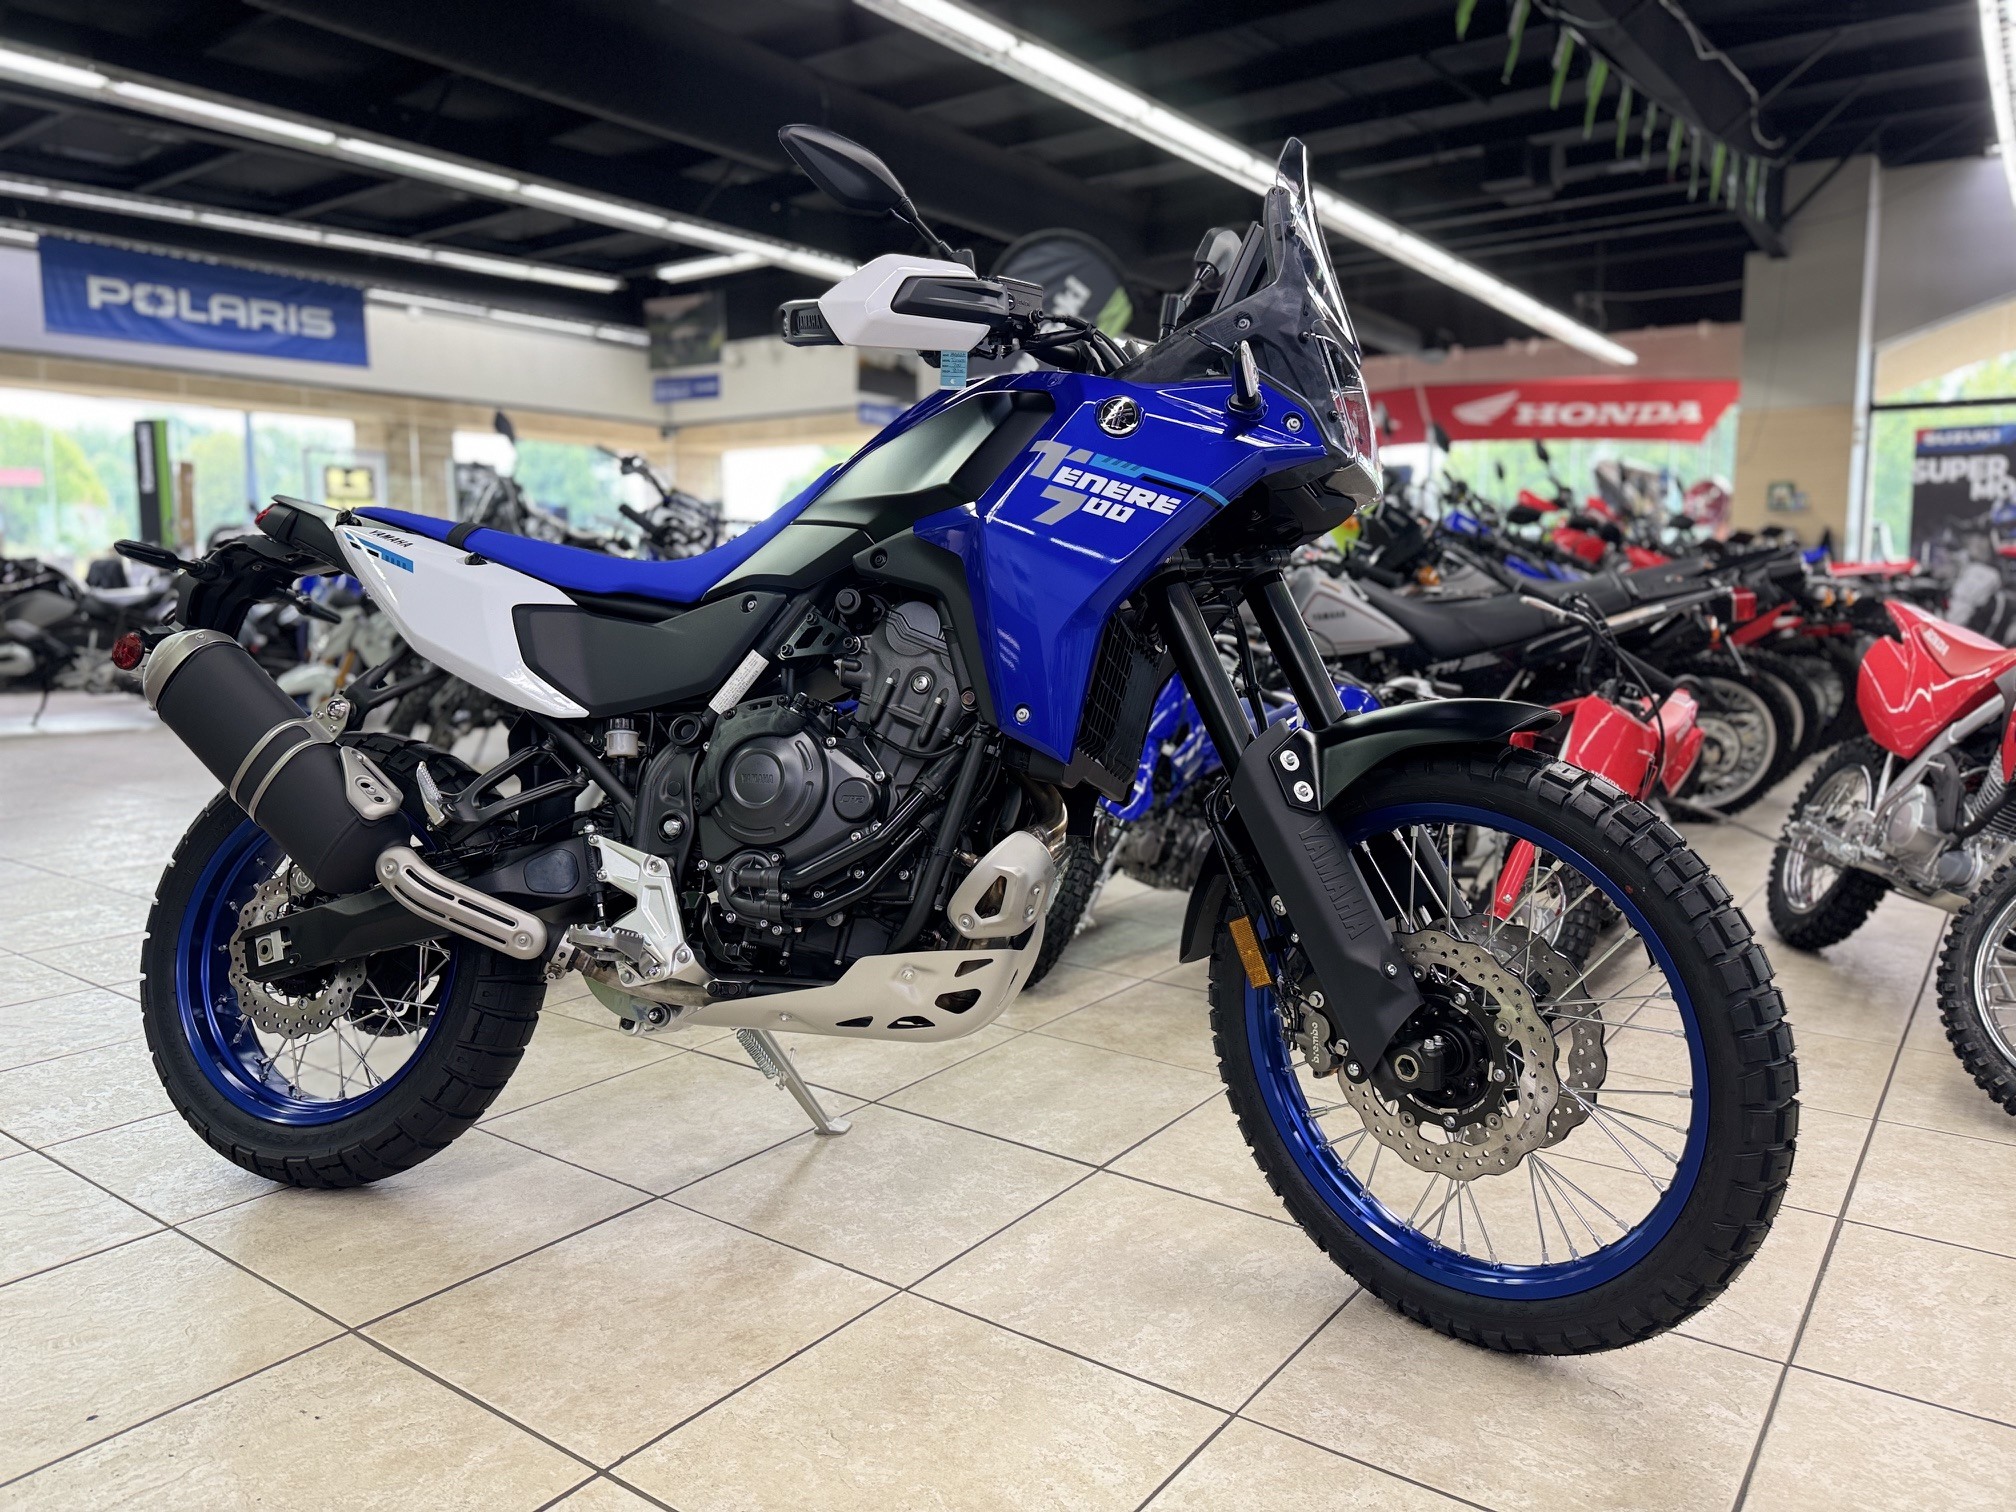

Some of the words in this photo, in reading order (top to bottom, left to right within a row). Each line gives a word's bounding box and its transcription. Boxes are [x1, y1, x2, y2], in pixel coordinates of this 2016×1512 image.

[86, 274, 337, 340] POLARIS
[1513, 400, 1702, 427] HONDA
[1923, 430, 2001, 447] SUZUKI
[1911, 454, 2009, 485] SUPER
[1032, 484, 1137, 527] 700
[368, 529, 414, 548] YAMAHA
[741, 773, 774, 784] YAMAHA
[1298, 818, 1377, 941] YAMAHA
[1310, 1021, 1320, 1064] brembo
